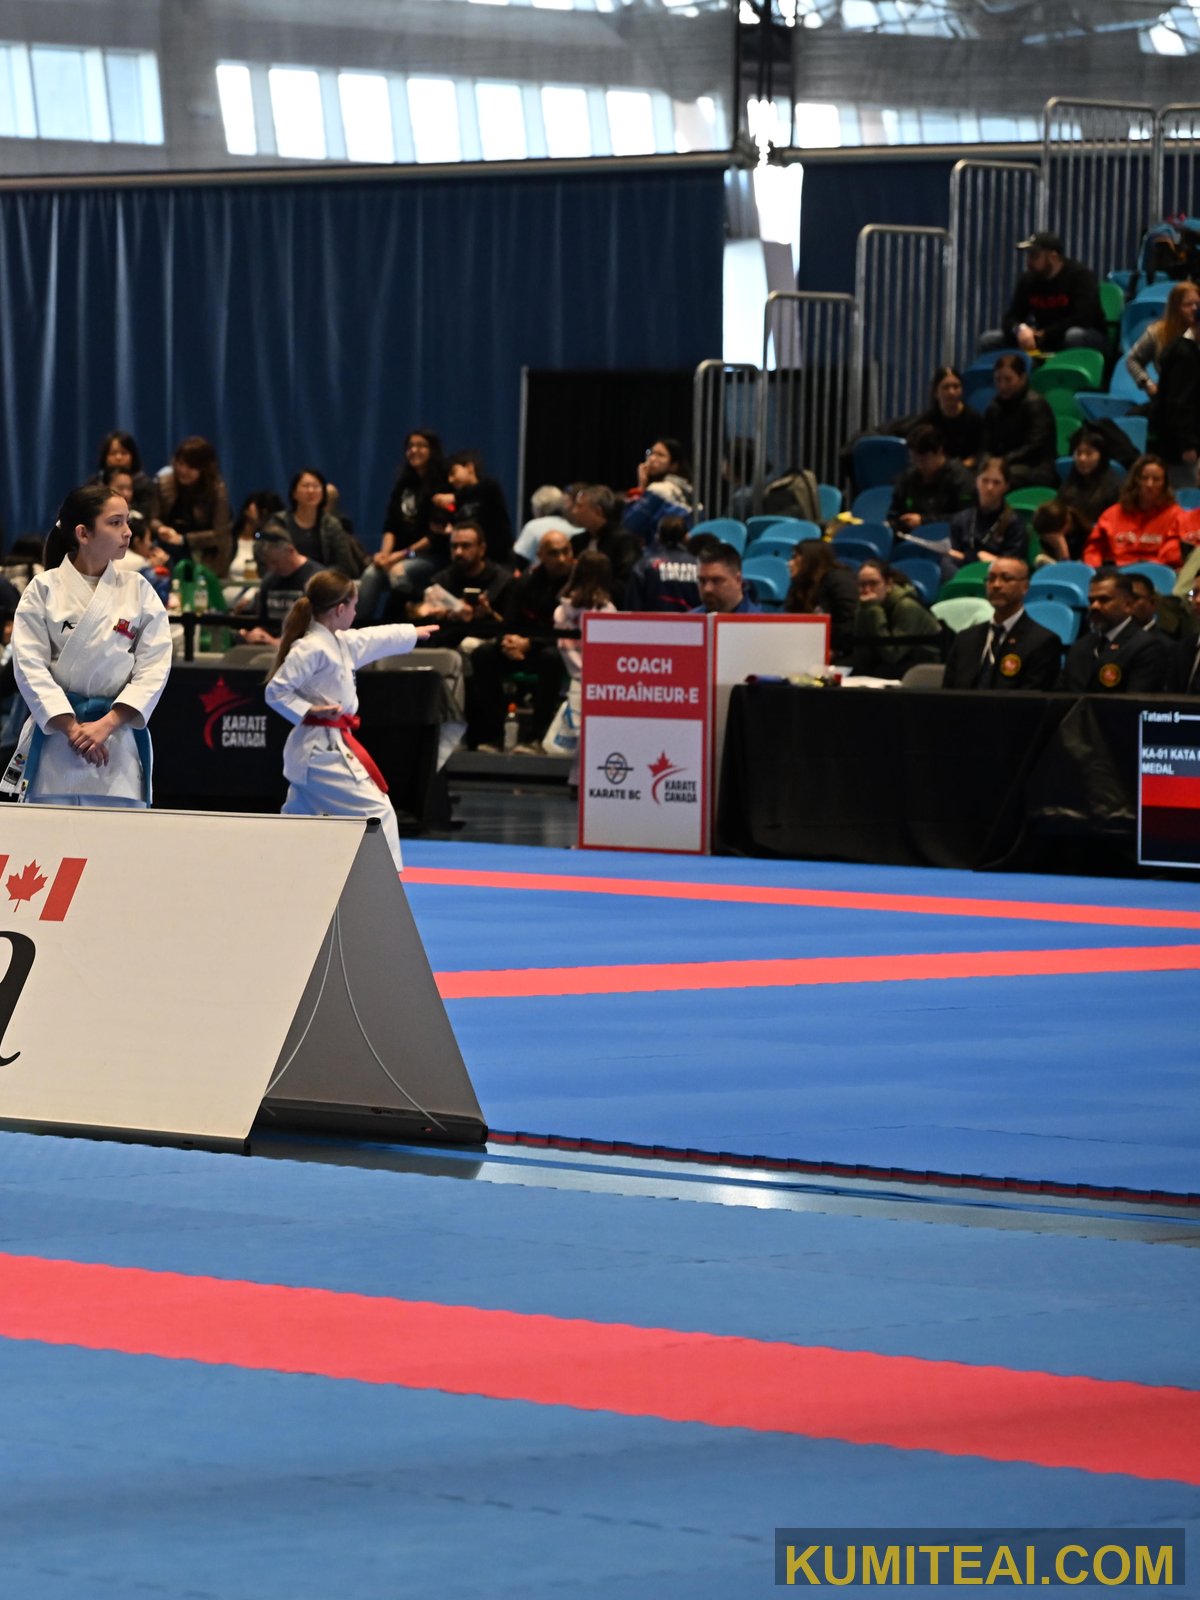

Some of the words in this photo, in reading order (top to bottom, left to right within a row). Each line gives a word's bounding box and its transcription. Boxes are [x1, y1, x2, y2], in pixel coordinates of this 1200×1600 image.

[616, 657, 673, 674] COACH
[222, 715, 267, 731] KARATE
[1142, 711, 1172, 723] Tatami
[222, 732, 267, 747] CANADA
[1170, 749, 1196, 761] KATA
[1142, 762, 1174, 775] MEDAL
[664, 780, 697, 791] KARATE
[589, 788, 626, 800] KARATE
[628, 790, 641, 800] BC
[664, 792, 698, 803] CANADA
